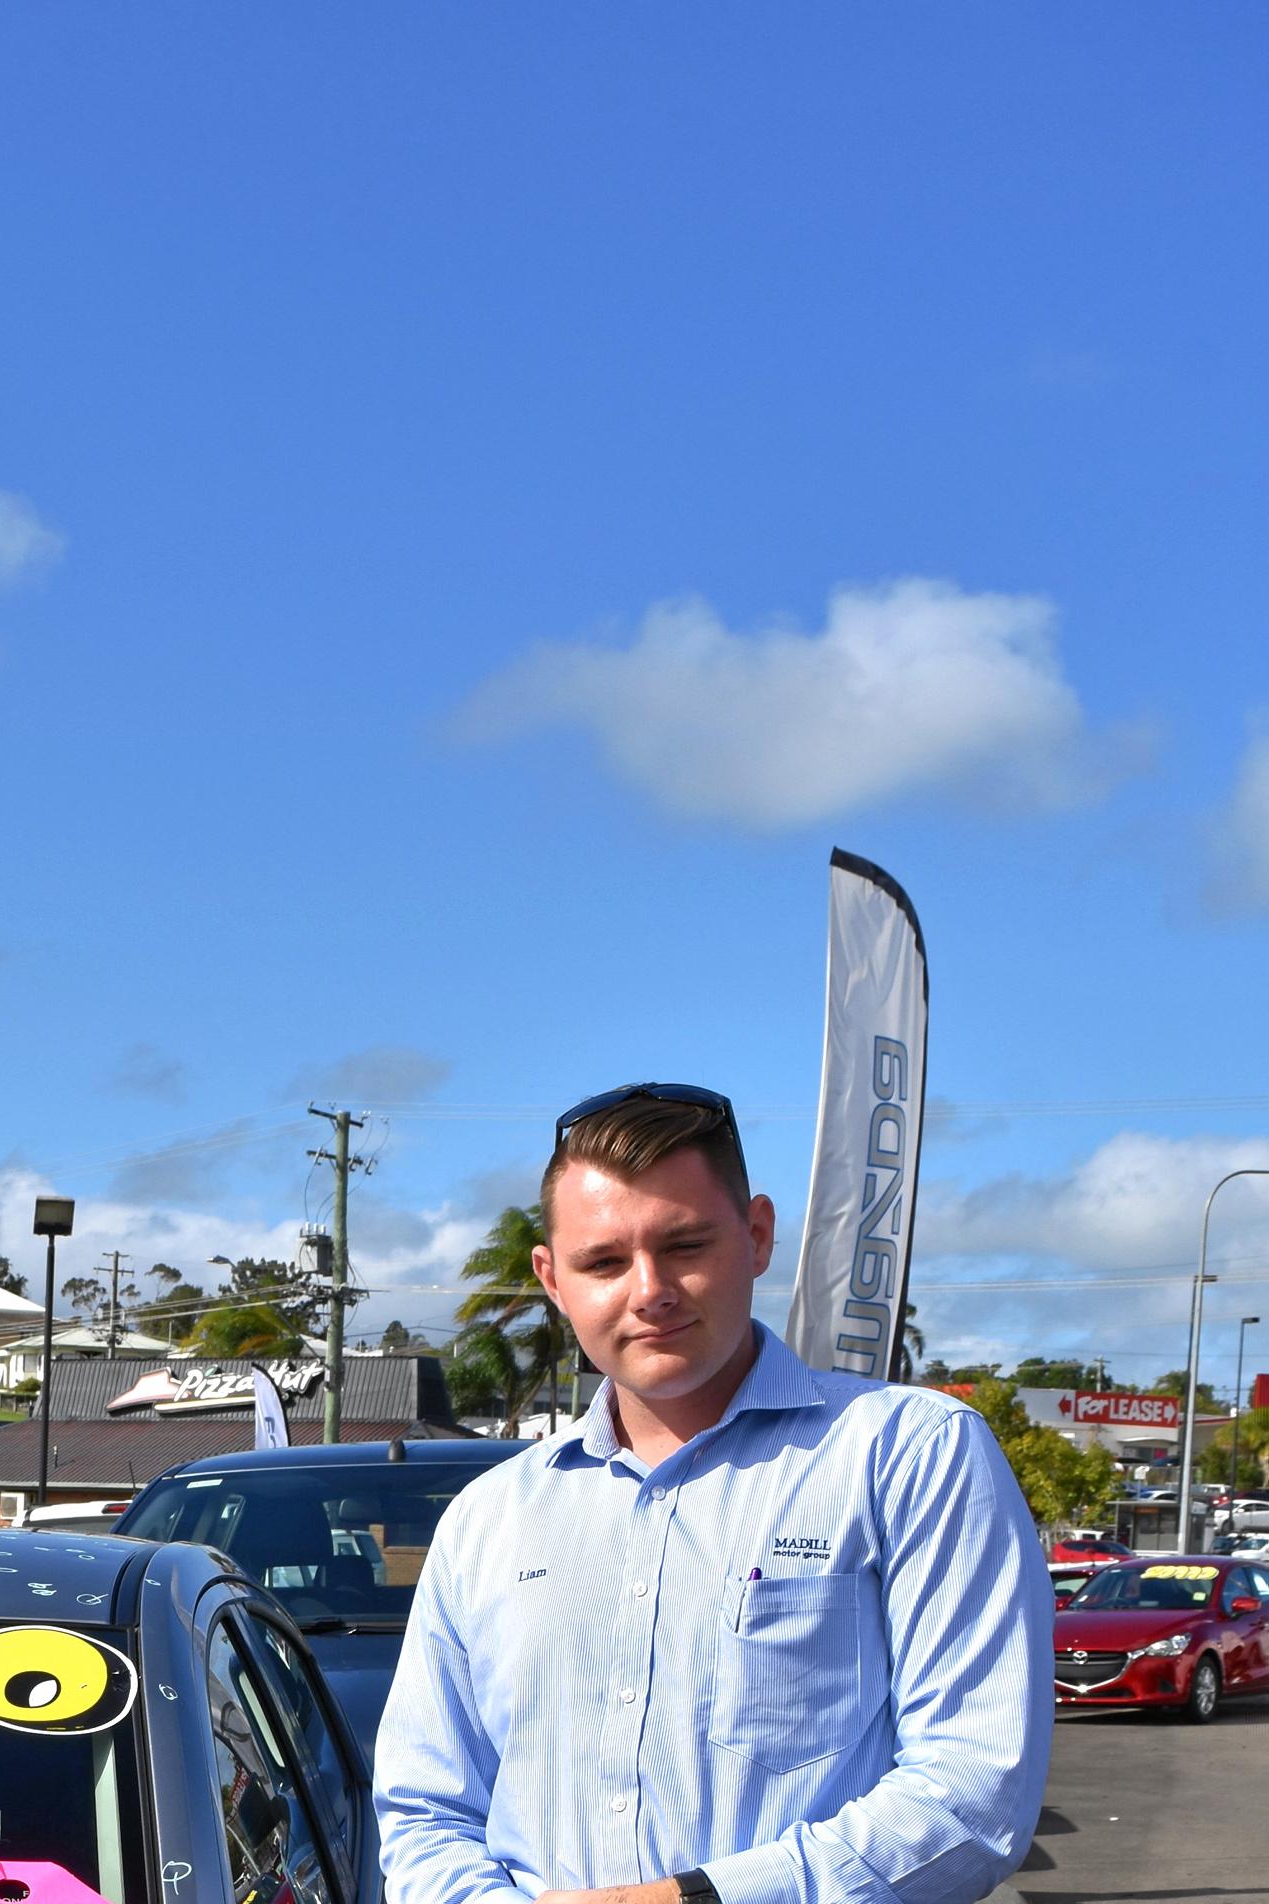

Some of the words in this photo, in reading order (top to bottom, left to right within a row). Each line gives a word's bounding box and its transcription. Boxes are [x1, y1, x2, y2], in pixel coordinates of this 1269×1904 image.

[174, 1366, 255, 1401] Pizza
[267, 1359, 325, 1393] Hut
[1109, 1398, 1163, 1422] LEASE
[774, 1538, 831, 1550] MADILL
[803, 1551, 830, 1560] group
[518, 1569, 546, 1582] Liam
